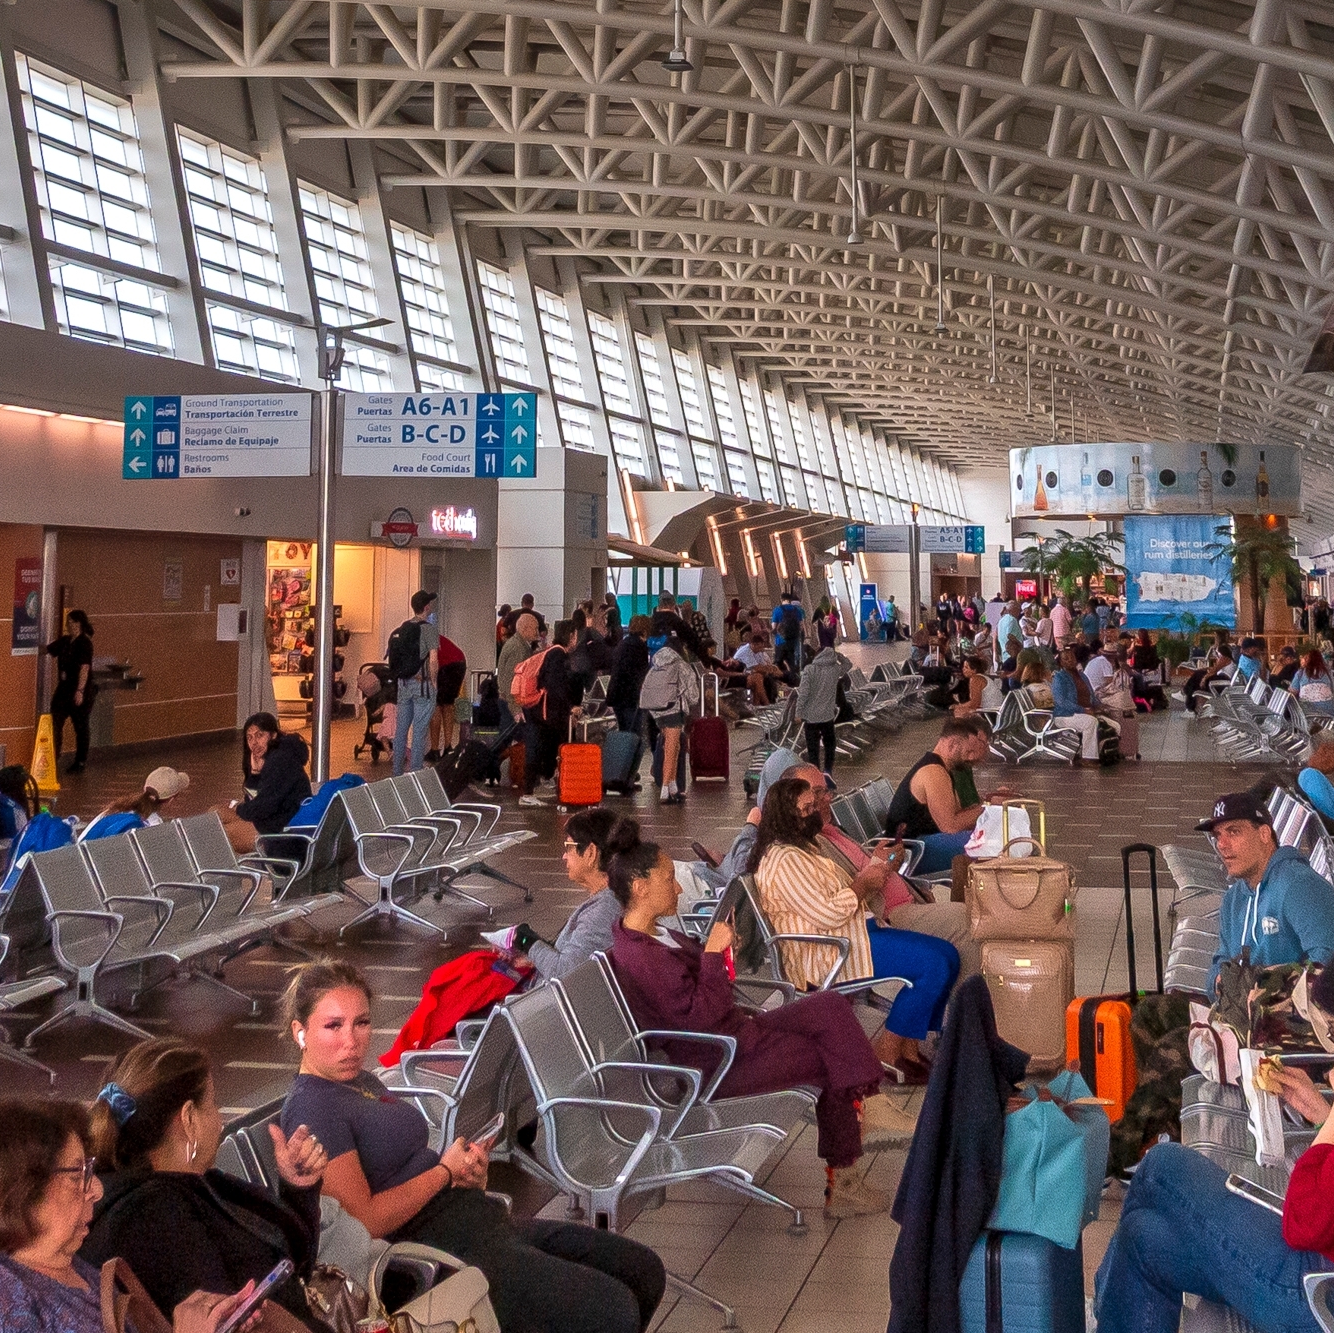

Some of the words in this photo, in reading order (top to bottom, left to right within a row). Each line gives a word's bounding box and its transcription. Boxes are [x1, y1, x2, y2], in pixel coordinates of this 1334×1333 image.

[185, 398, 217, 408] Ground
[220, 398, 284, 409] Transportation
[368, 395, 393, 404] Gates
[401, 397, 469, 416] A6-A1
[185, 409, 254, 419] Transportación
[257, 409, 299, 418] Terrestre
[357, 407, 393, 416] Puertas
[184, 426, 222, 436] Baggage
[224, 426, 249, 434] Claim
[367, 424, 392, 432] Gates
[401, 424, 466, 444] B-C-D
[184, 438, 224, 446] Reclamo
[226, 437, 237, 445] de
[239, 437, 279, 447] Equipaje
[357, 435, 392, 443] Puertas
[184, 454, 229, 462] Restrooms
[422, 453, 444, 462] Food
[446, 453, 471, 462] Court
[184, 465, 212, 474] Baños
[392, 464, 414, 473] Area
[416, 464, 428, 473] de
[430, 464, 471, 473] Comidas
[1150, 539, 1190, 548] Discover
[1166, 550, 1213, 559] distilleries
